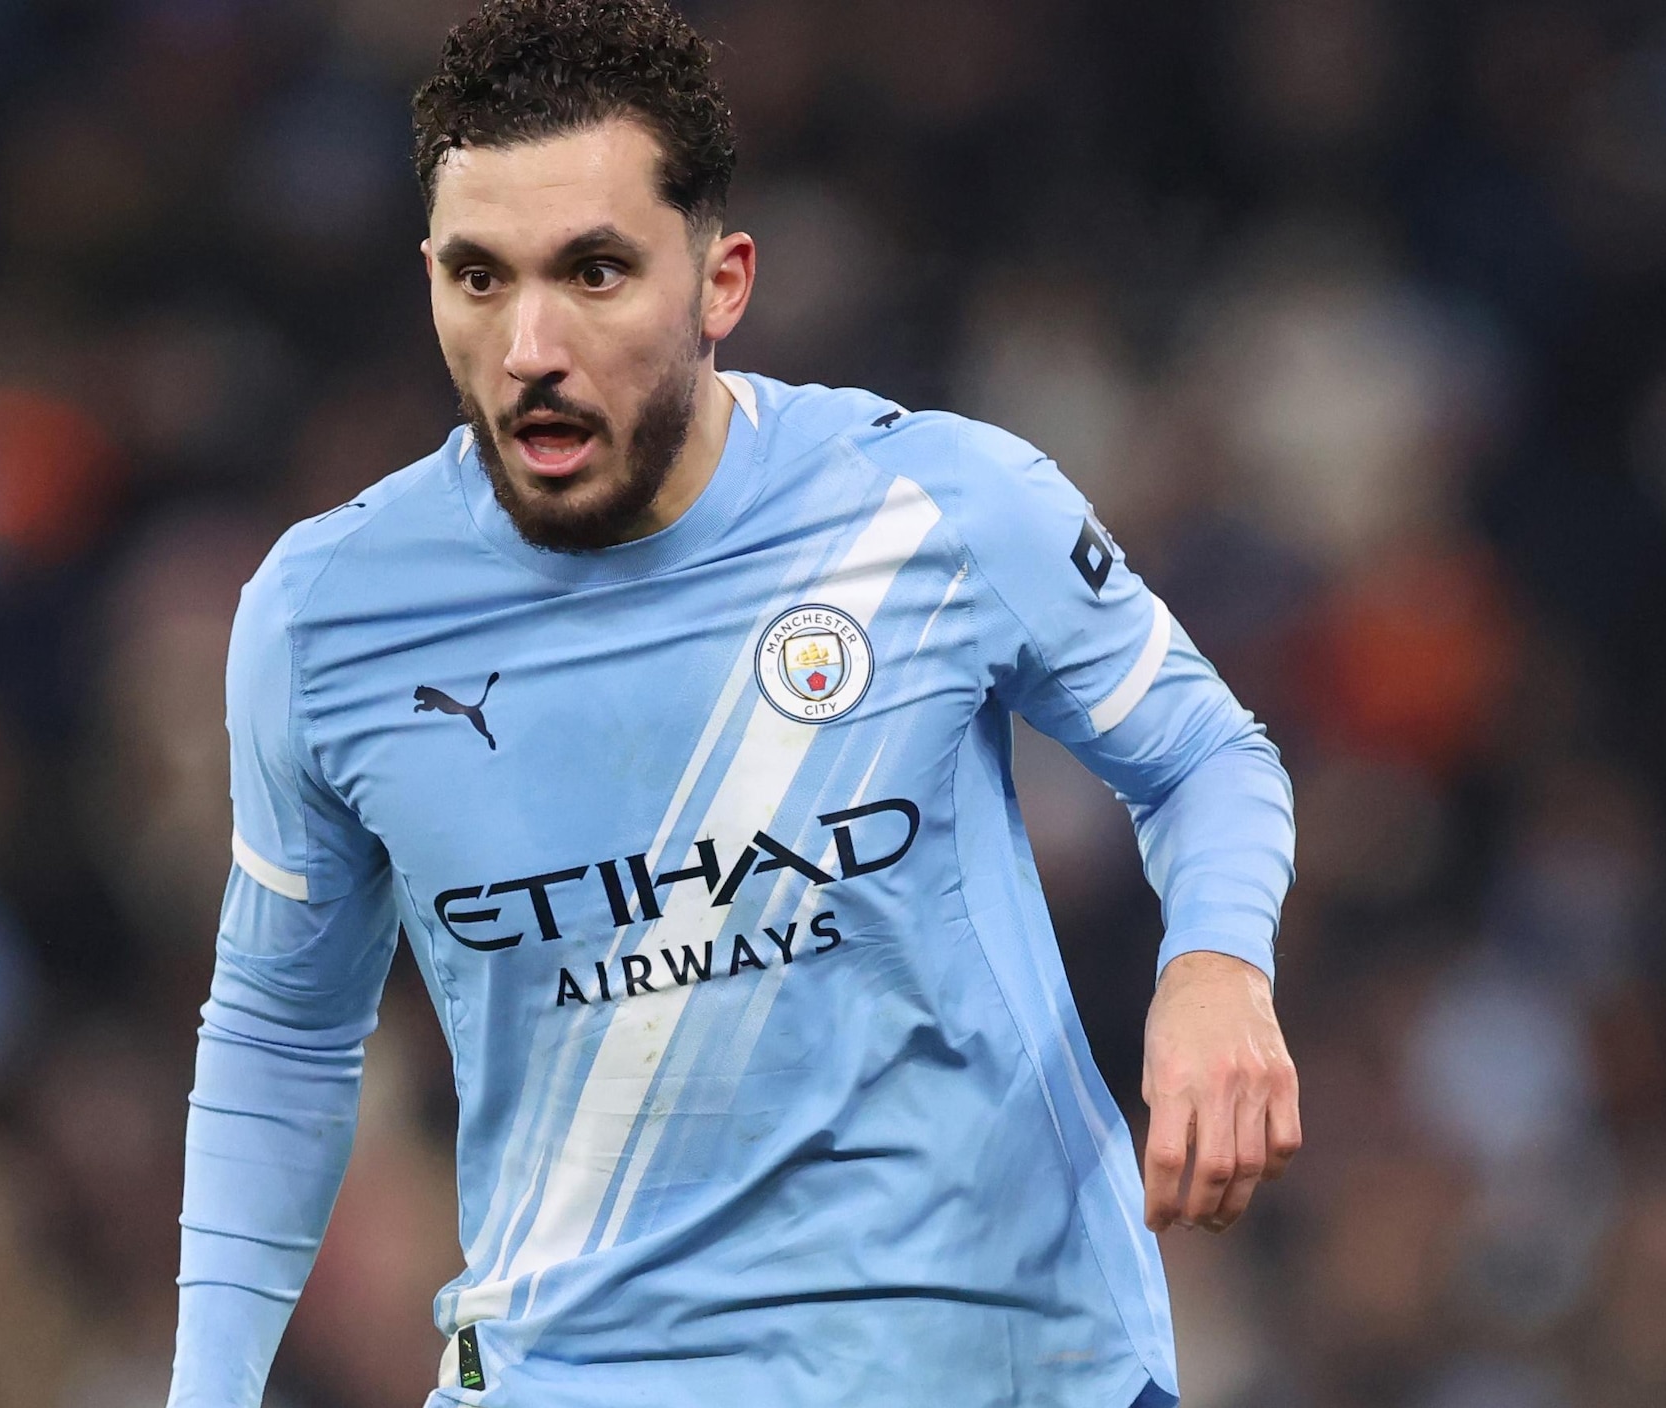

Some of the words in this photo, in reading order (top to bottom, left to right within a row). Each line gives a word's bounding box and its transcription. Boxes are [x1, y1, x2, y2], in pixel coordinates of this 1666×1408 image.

[767, 613, 858, 655] MANCHESTER
[804, 702, 837, 716] CITY
[433, 798, 920, 951] ETIHAD
[556, 911, 841, 1007] AIRWAYS
